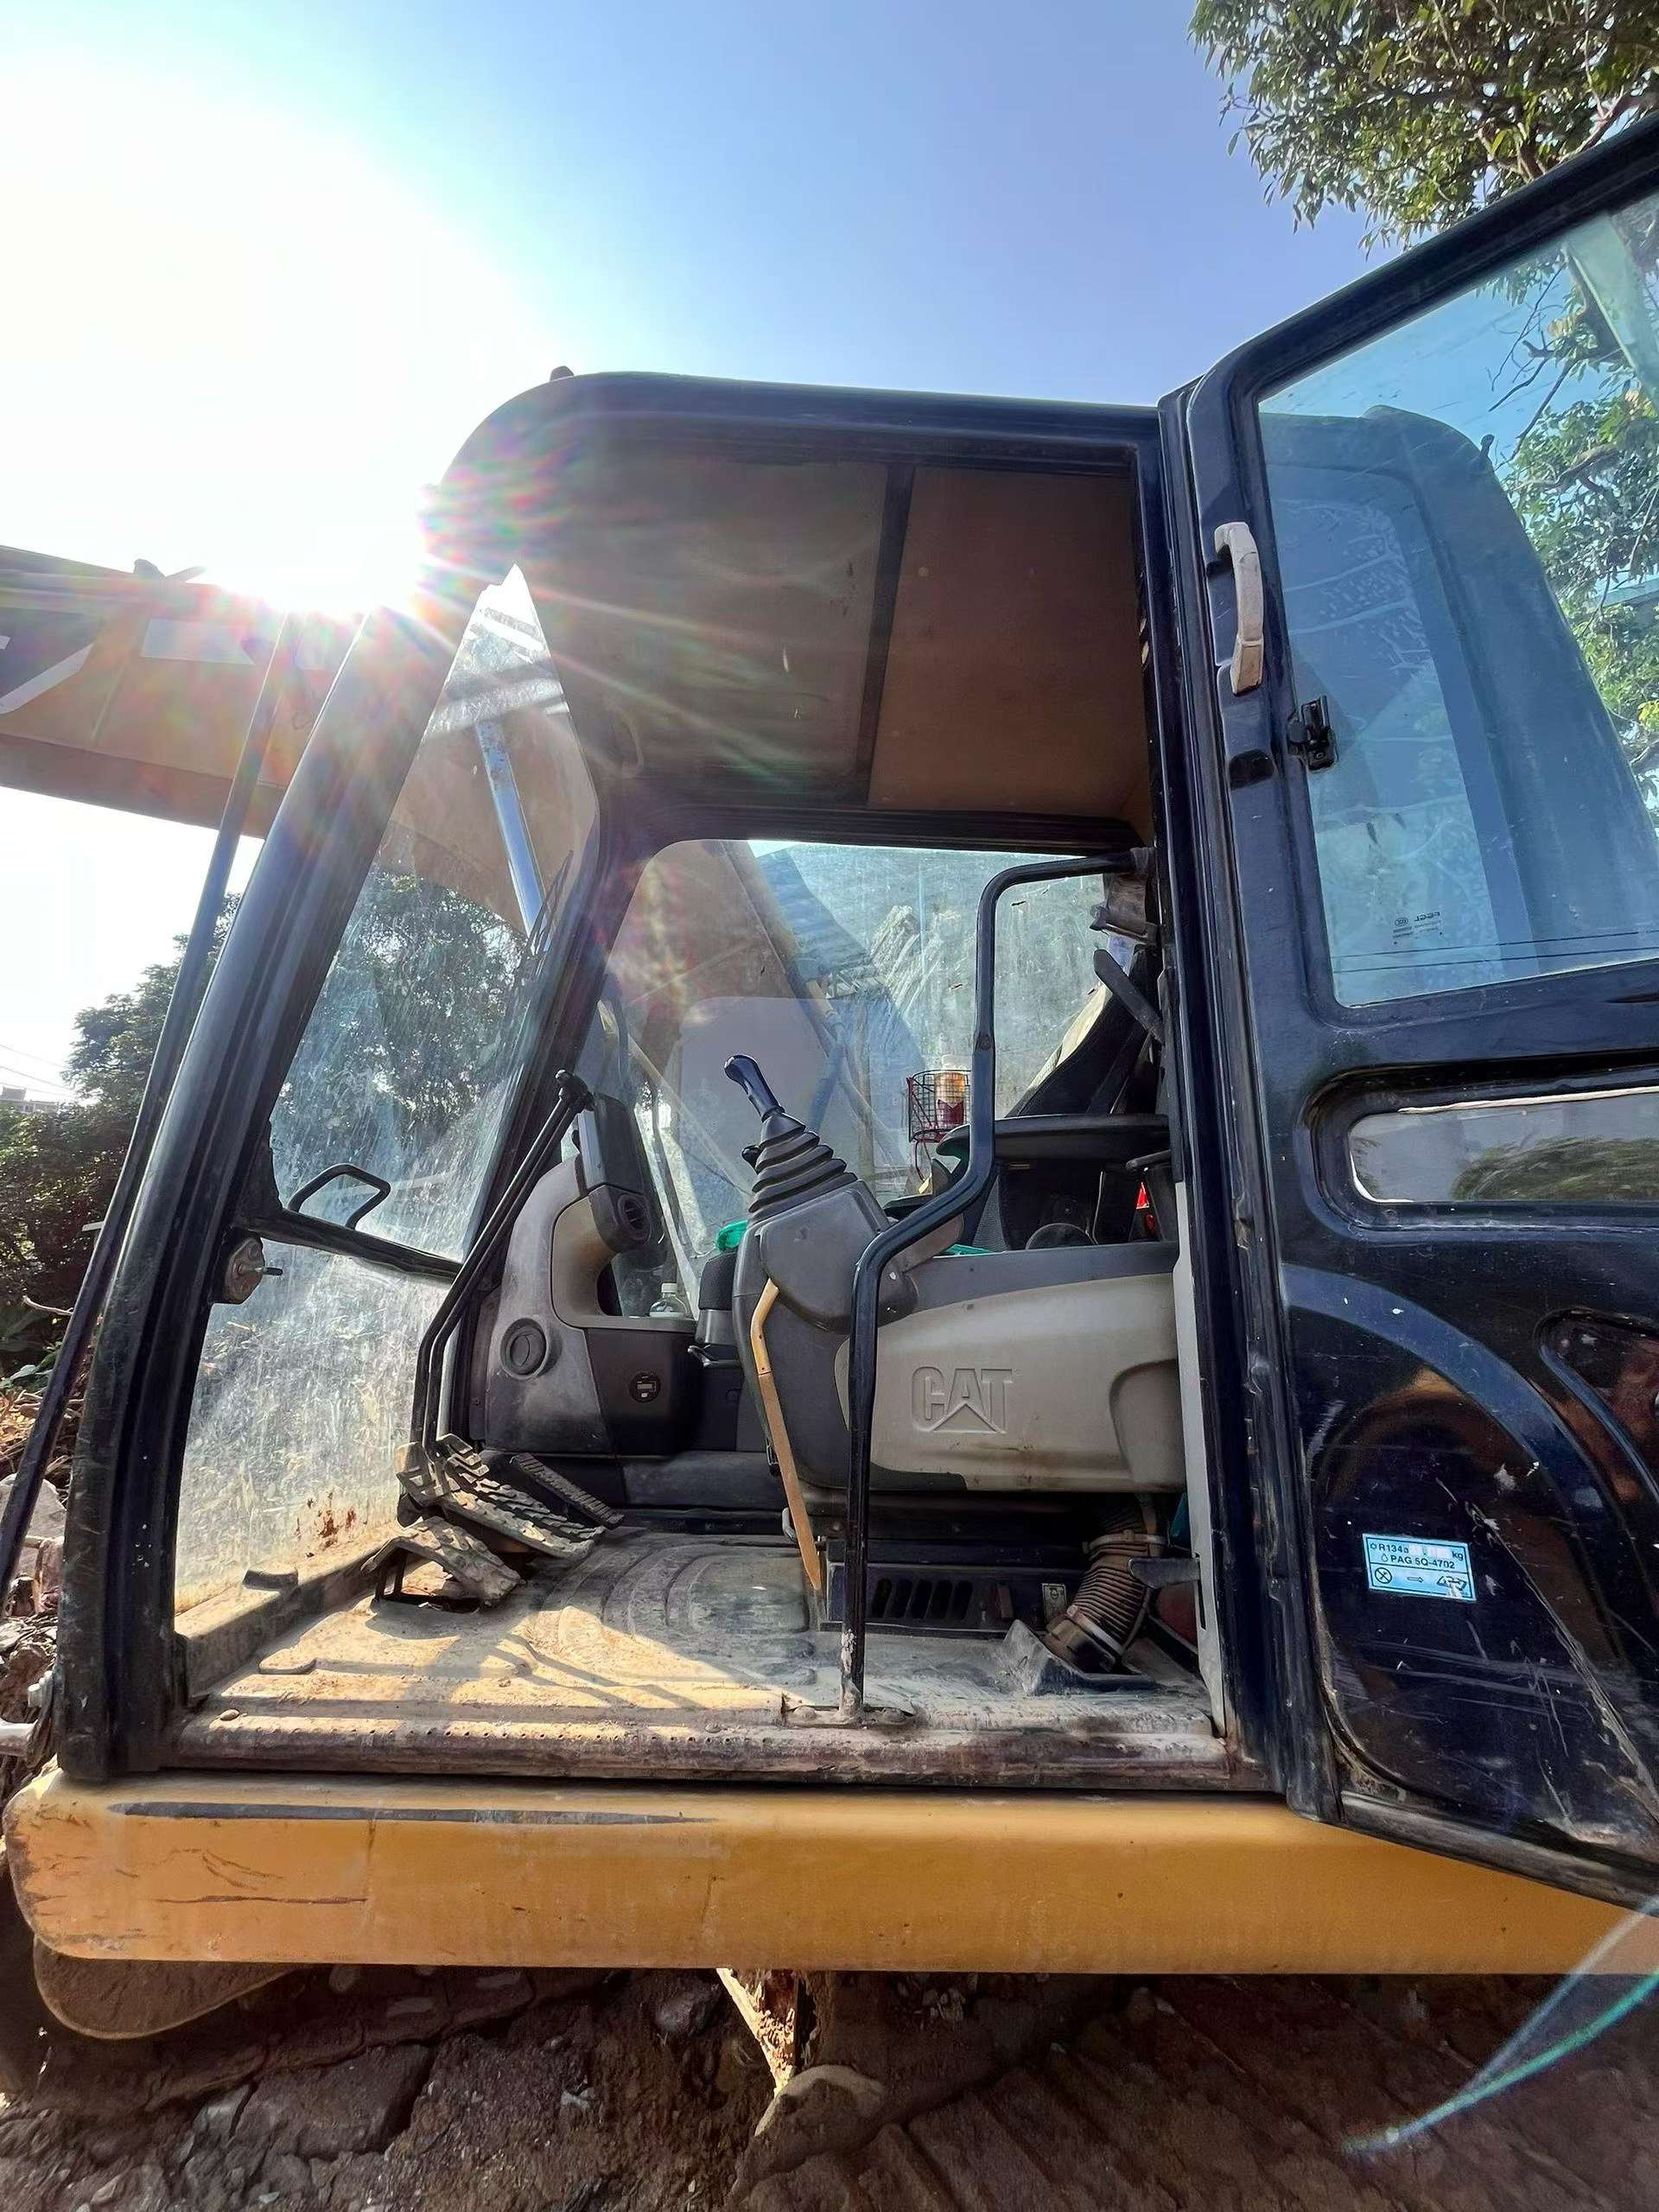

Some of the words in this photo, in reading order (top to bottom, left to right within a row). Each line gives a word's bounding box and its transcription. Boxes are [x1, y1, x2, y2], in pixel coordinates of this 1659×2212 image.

[912, 1366, 1013, 1433] CAT
[1378, 1544, 1409, 1554] R134a
[1452, 1551, 1464, 1560] kg
[1390, 1555, 1412, 1565] PAG
